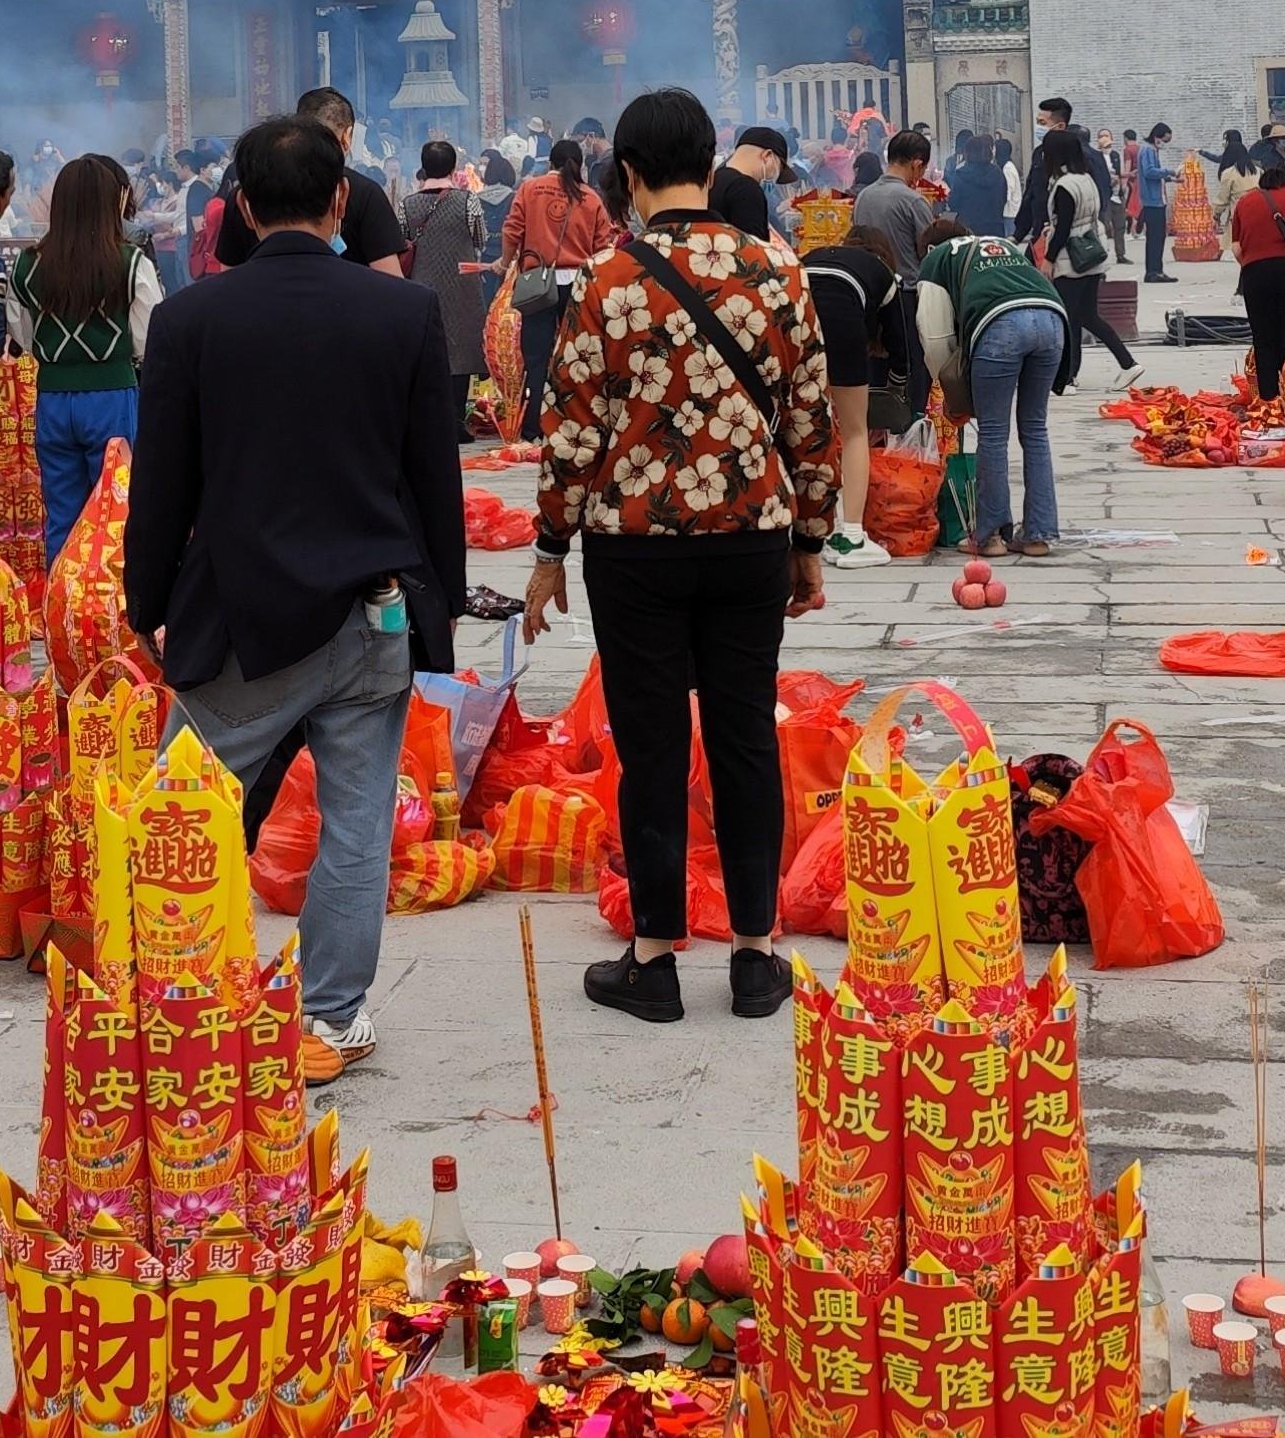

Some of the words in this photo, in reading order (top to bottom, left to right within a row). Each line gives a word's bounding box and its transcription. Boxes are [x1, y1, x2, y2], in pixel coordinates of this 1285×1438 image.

[51, 823, 76, 878] 必應
[817, 791, 843, 808] OPP
[87, 1011, 141, 1113] 平安
[140, 1007, 188, 1111] 合家
[189, 1004, 242, 1107] 平安
[241, 999, 294, 1101] 合家
[834, 1033, 892, 1142] 事成
[902, 1042, 958, 1151] 心想
[961, 1043, 1014, 1149] 事成
[1019, 1036, 1076, 1141] 心想
[91, 1244, 122, 1270] 財
[209, 1244, 241, 1270] 財
[73, 1292, 165, 1406] 財
[168, 1286, 276, 1402] 財
[809, 1288, 873, 1397] 興隆
[879, 1297, 933, 1409] 生意
[934, 1300, 994, 1411] 興隆
[1002, 1296, 1065, 1405] 生意
[1093, 1271, 1135, 1373] 生意
